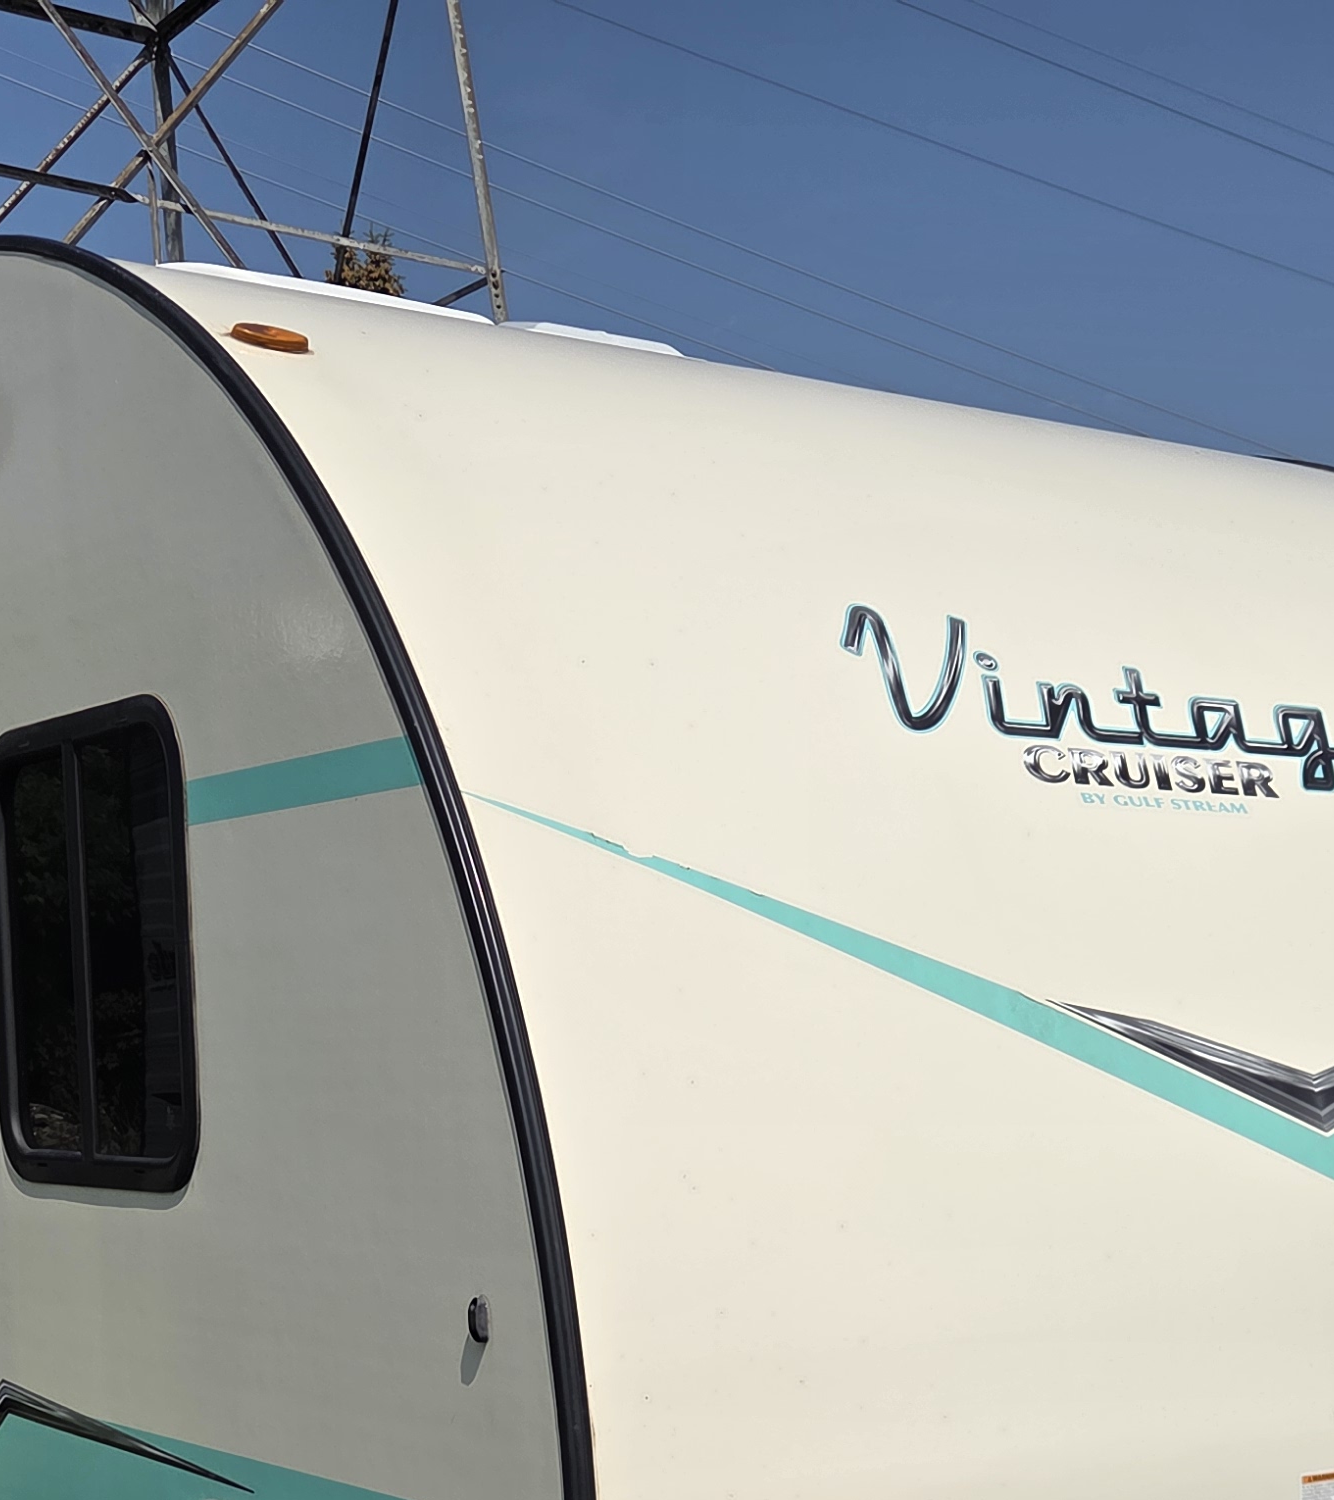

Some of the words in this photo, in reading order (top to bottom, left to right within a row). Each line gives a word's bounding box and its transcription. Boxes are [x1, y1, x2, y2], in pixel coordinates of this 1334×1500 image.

[1023, 743, 1279, 799] CRUISER
[1080, 792, 1105, 805] BY
[1113, 794, 1165, 809] GULF
[1170, 798, 1248, 815] STREAM
